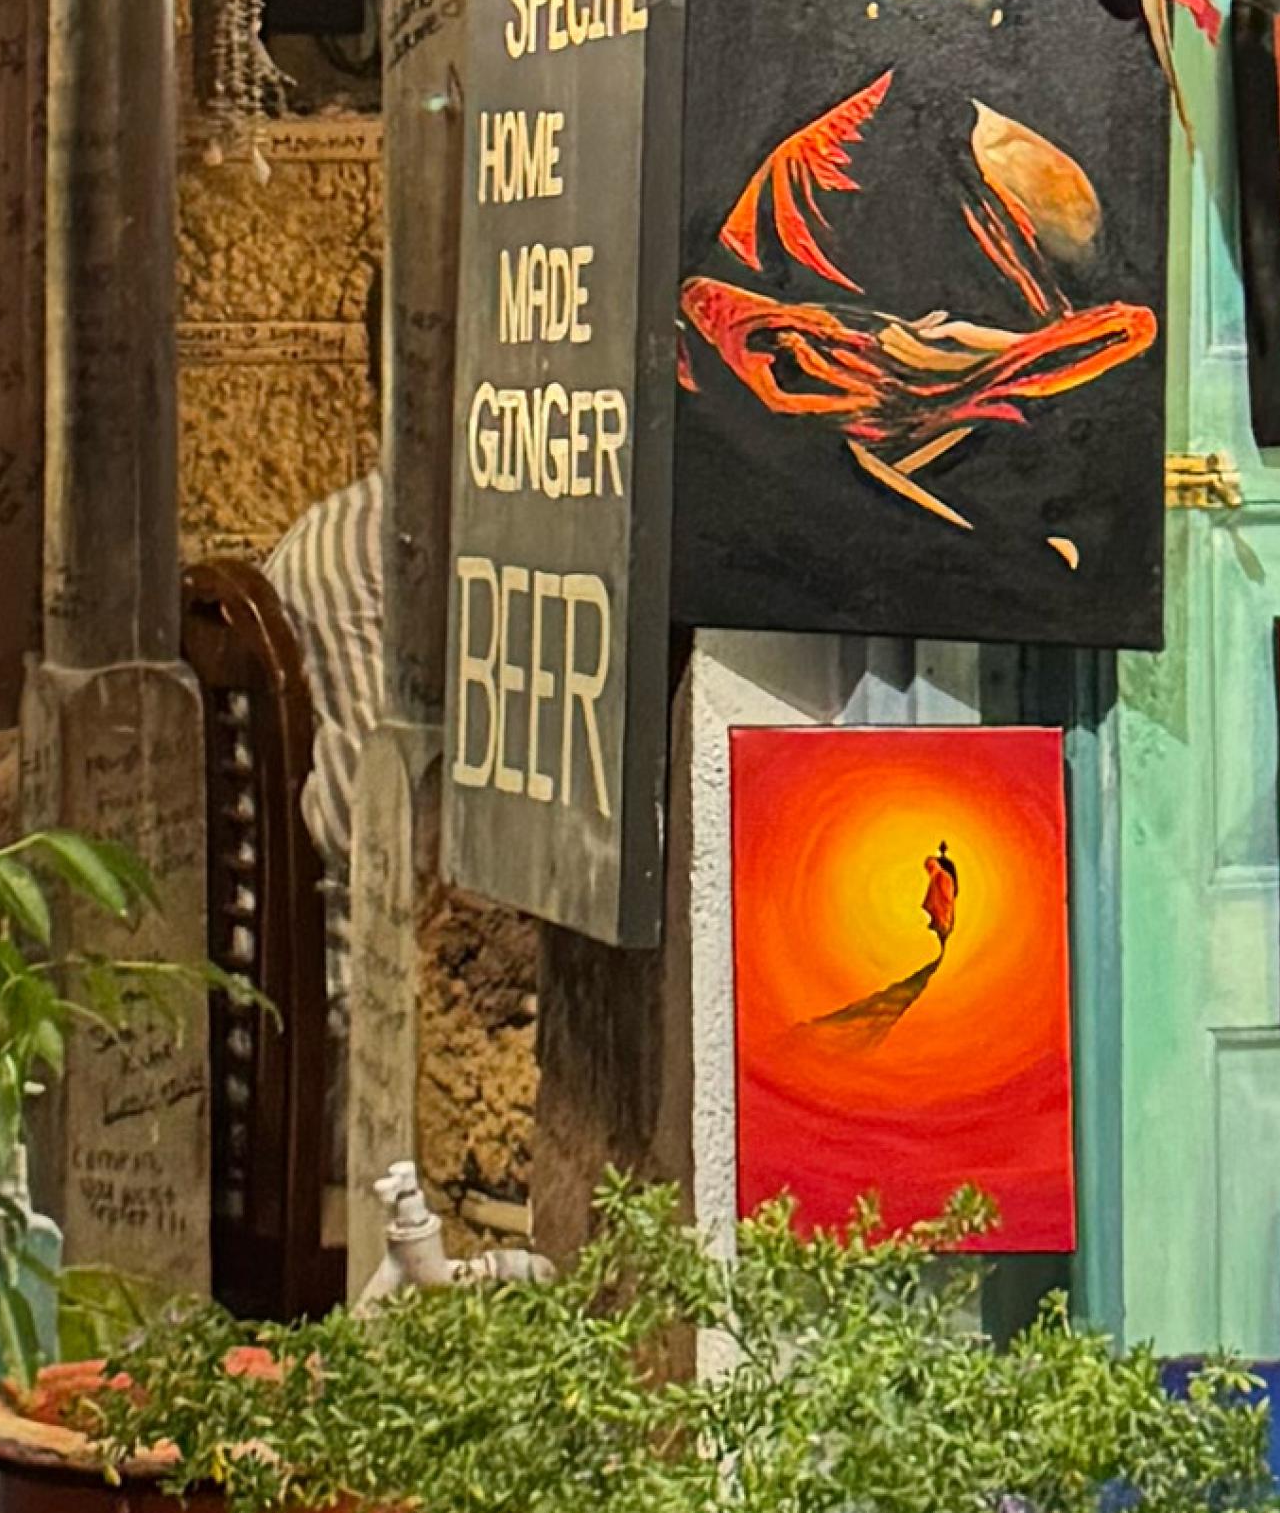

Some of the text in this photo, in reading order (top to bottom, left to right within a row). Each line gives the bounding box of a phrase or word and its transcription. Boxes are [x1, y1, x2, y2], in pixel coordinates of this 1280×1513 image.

[477, 110, 565, 204] HOME
[498, 243, 595, 344] MADE
[468, 381, 628, 499] GINGER
[452, 556, 611, 818] BEER
